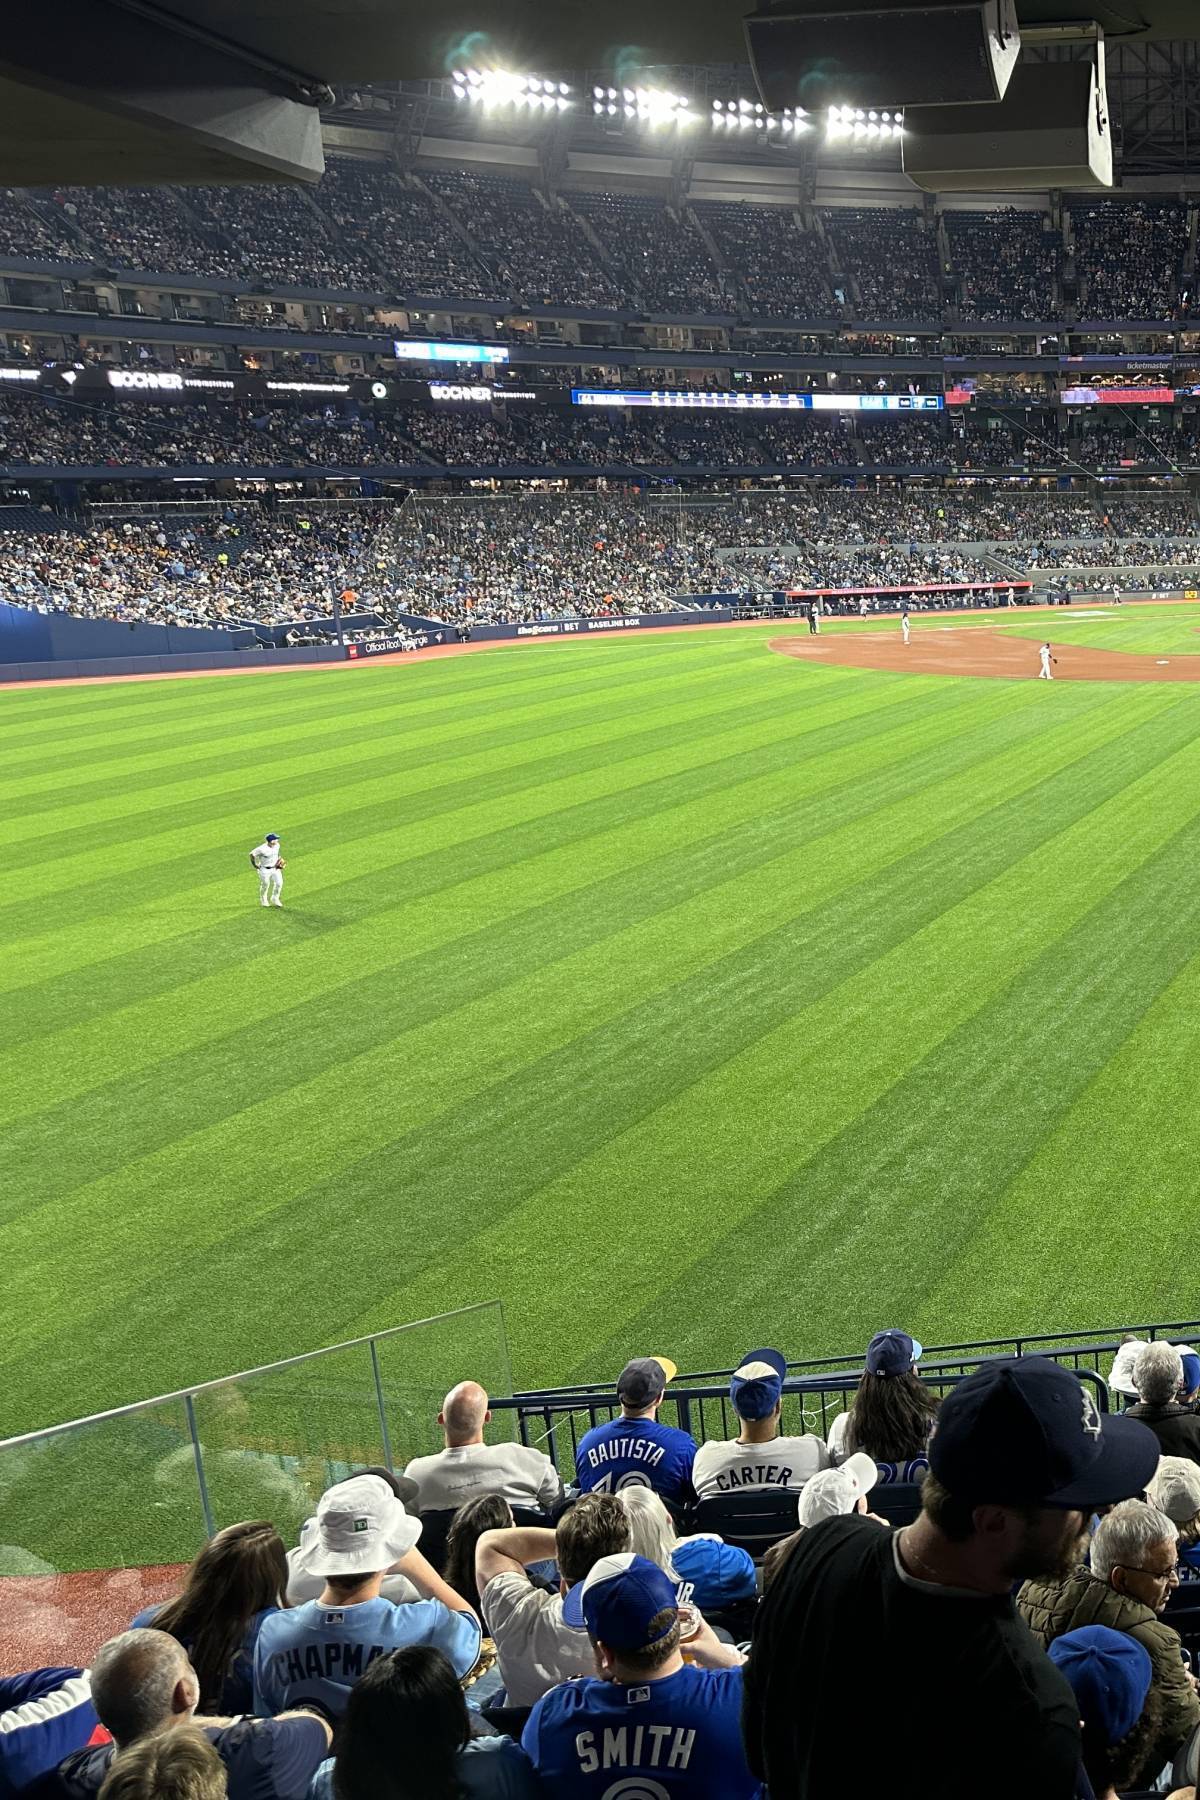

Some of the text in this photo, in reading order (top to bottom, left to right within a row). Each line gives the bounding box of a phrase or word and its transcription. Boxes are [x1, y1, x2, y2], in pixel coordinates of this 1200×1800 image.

[1126, 361, 1170, 370] ticketmaster
[430, 385, 492, 401] BOCHNER
[517, 618, 640, 635] theScore BET BASELINE BOX
[365, 639, 387, 653] Official
[587, 1437, 666, 1468] BAUTISTA
[715, 1464, 793, 1491] CARTER
[354, 1520, 367, 1530] TD
[273, 1643, 400, 1687] CHAPMA
[576, 1725, 697, 1773] SMITH
